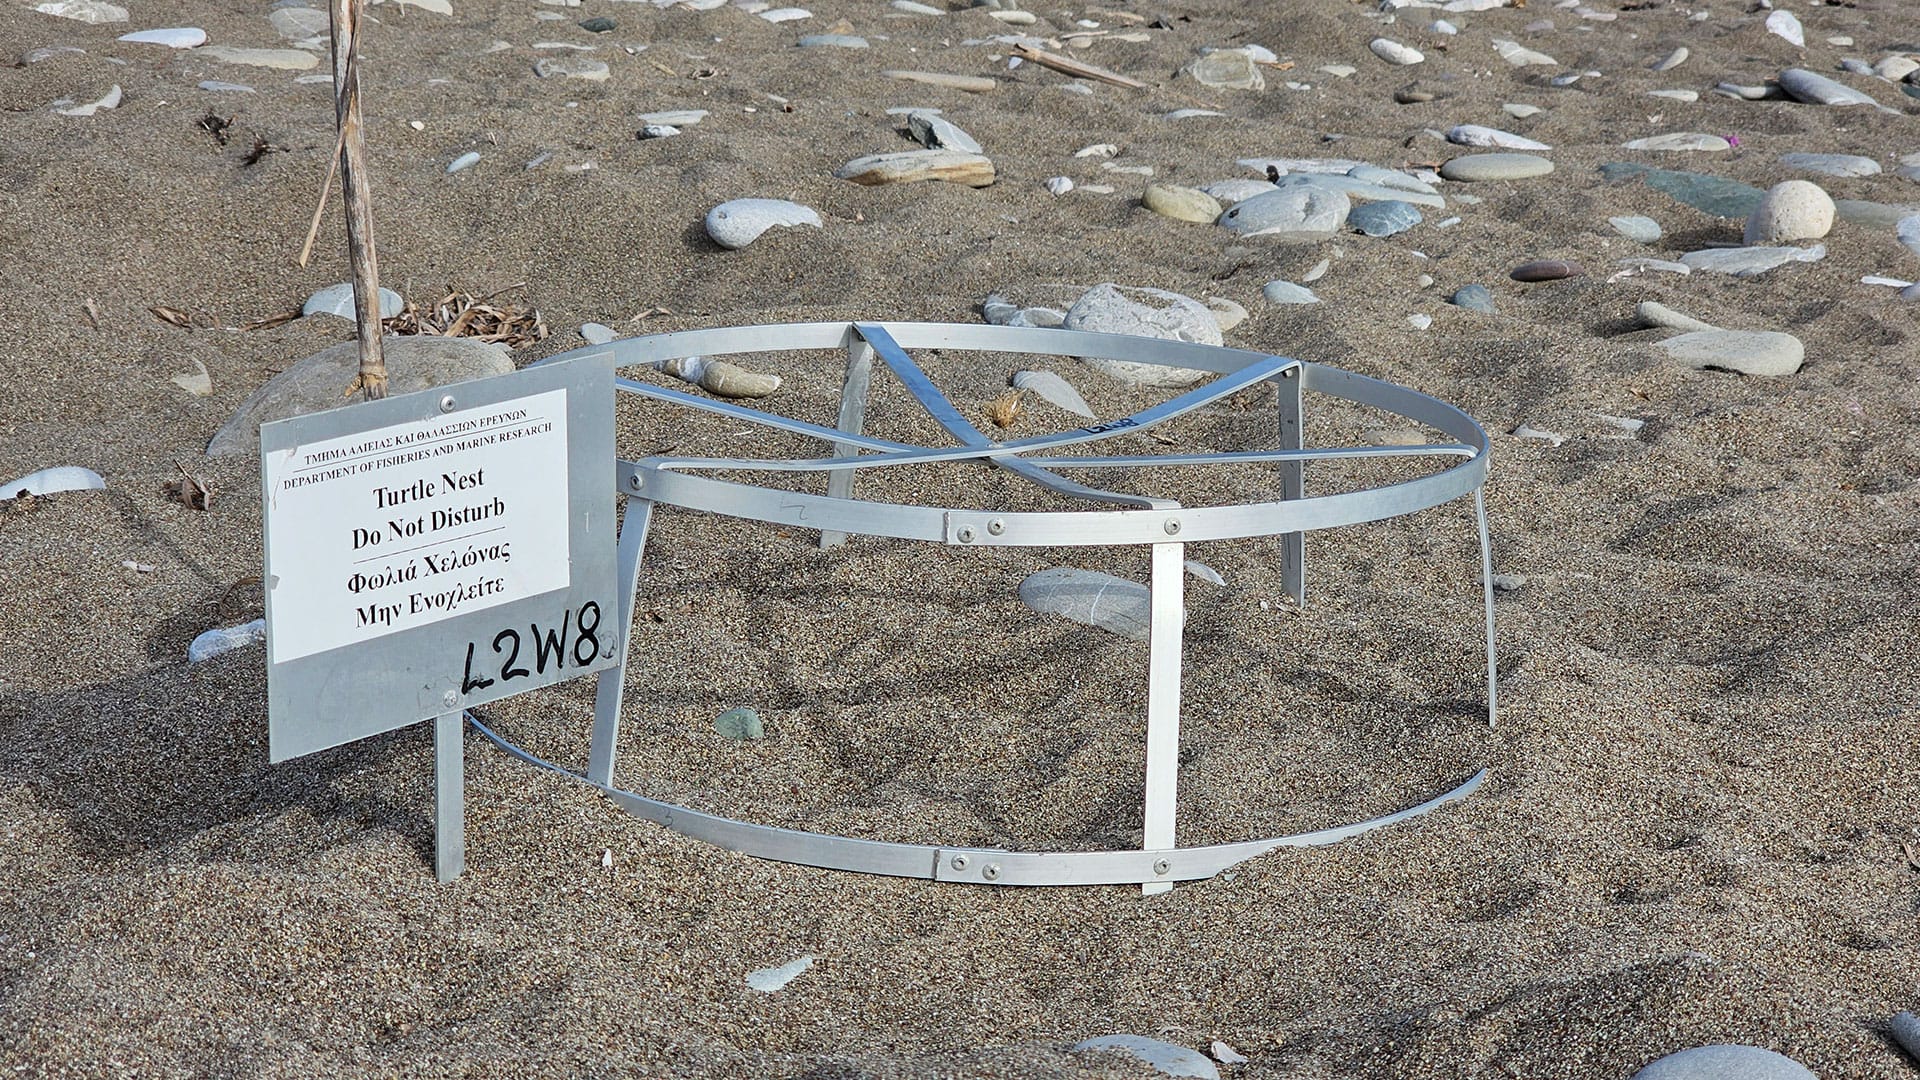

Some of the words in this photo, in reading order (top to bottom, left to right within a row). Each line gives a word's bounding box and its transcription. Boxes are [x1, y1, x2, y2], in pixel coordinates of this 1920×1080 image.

[283, 465, 358, 491] DEPARTMENT
[360, 461, 375, 473] OF
[376, 449, 431, 470] FISHERIES
[432, 444, 454, 458] AND
[456, 434, 497, 452] MARINE
[499, 422, 552, 443] RESEARCH
[304, 448, 347, 465] ΤΜΗΜΑ
[395, 433, 415, 446] ΚΑΙ
[480, 409, 528, 428] ΕΡΕΥΝΩΝ
[373, 479, 435, 510] Turtle
[441, 467, 485, 495] Nest
[352, 527, 381, 551] Do
[388, 515, 424, 543] Not
[431, 496, 505, 532] Disturb
[347, 559, 418, 595] Φωλιά
[423, 542, 512, 578] Χελώνας
[355, 603, 402, 629] Μην
[409, 576, 505, 616] Ενοχλείτε
[461, 600, 601, 695] L2W8
